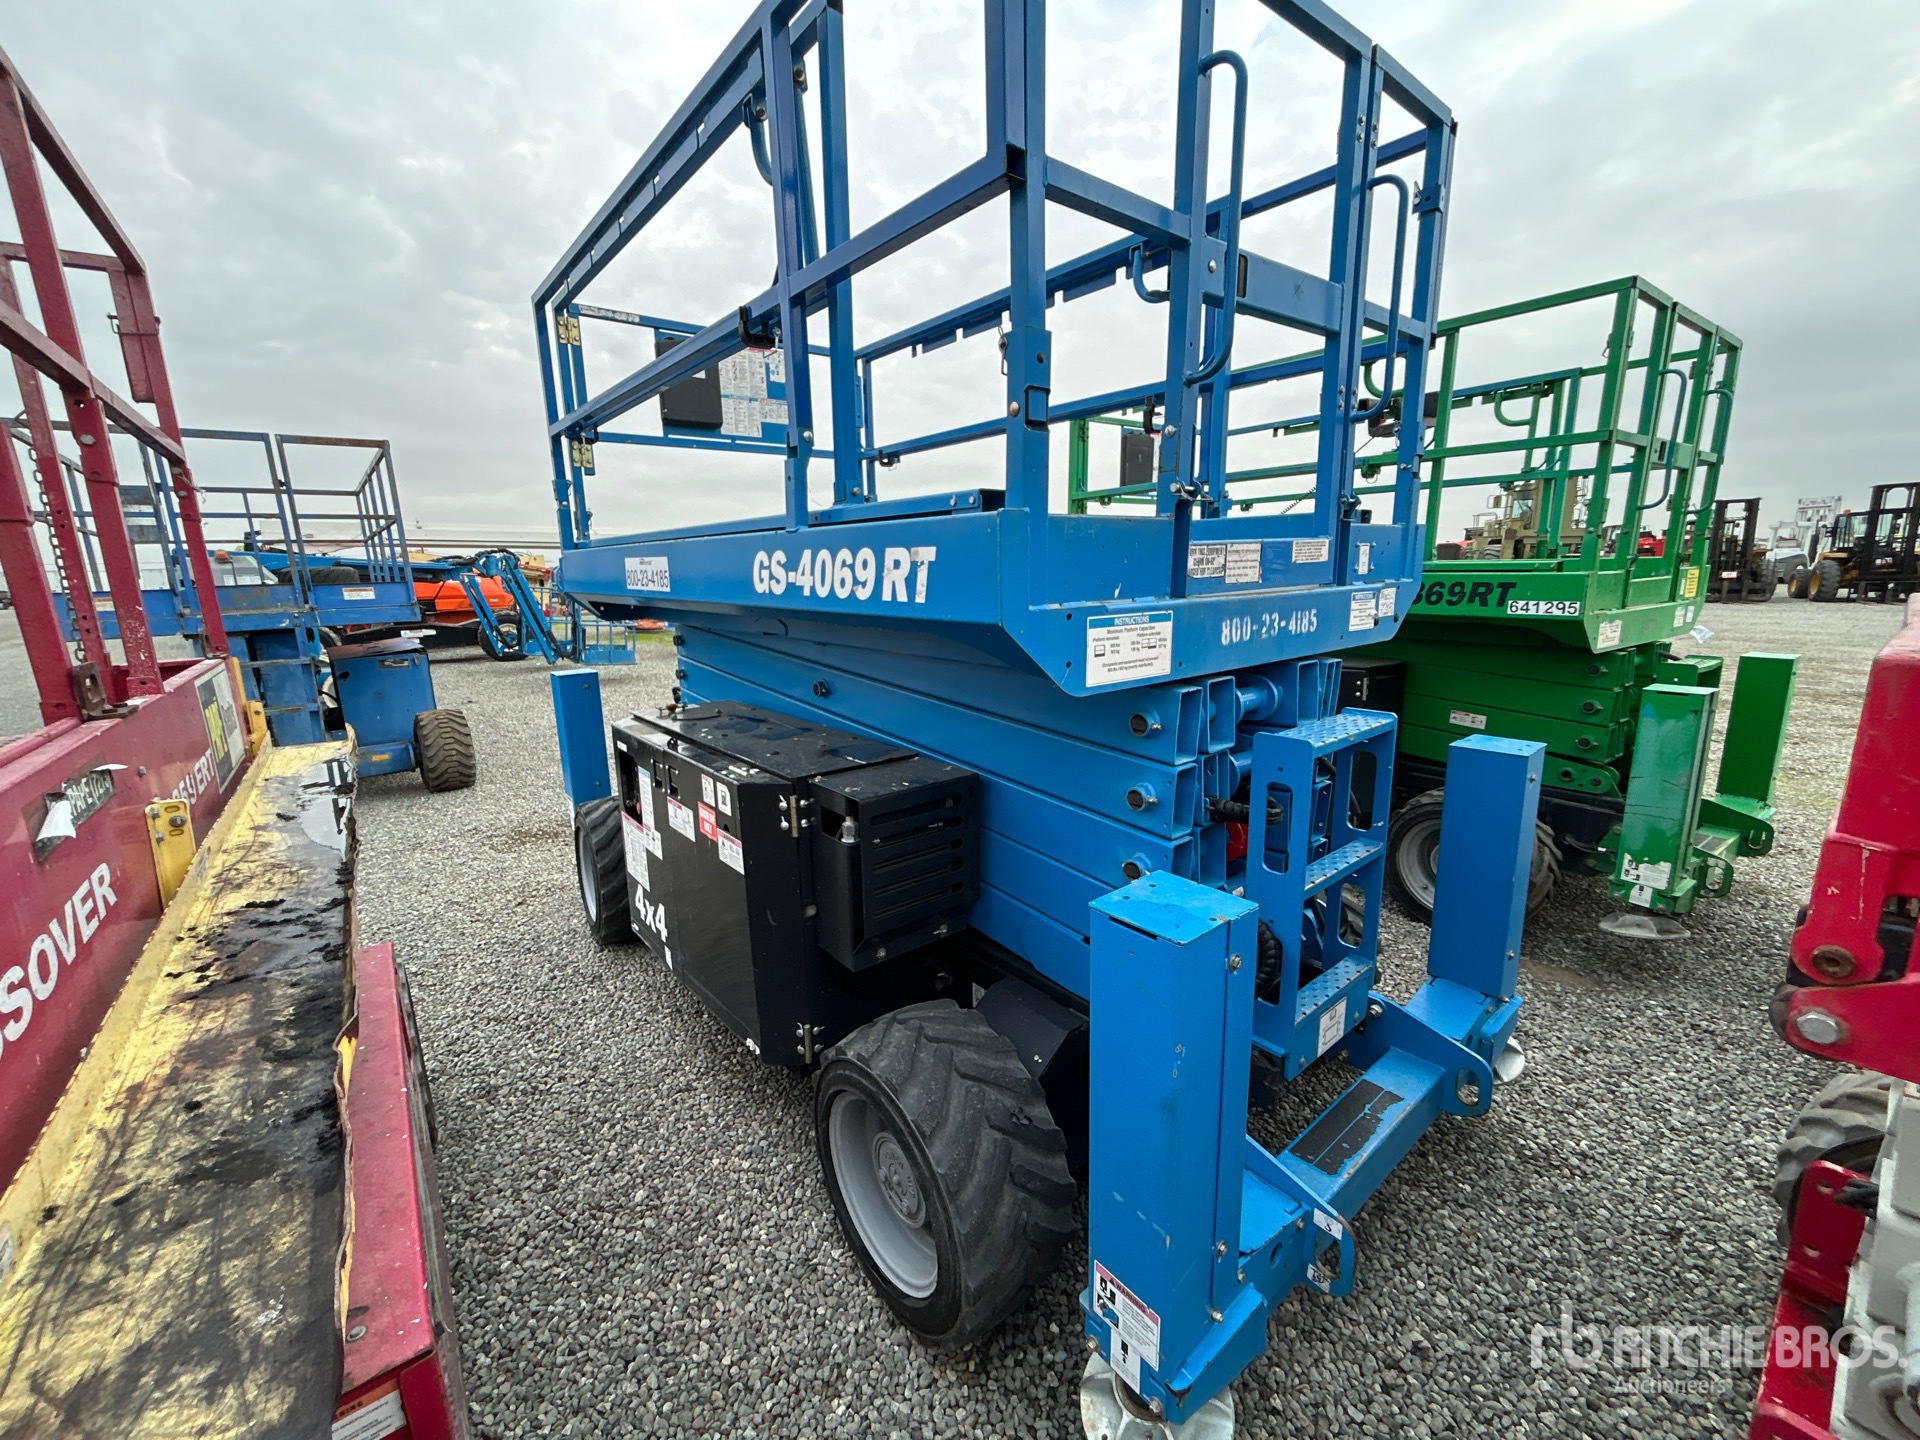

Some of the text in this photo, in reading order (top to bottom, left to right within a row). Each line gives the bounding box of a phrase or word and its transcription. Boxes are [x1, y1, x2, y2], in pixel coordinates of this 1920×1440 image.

[626, 569, 669, 588] 800-23-4185
[753, 546, 937, 603] GS-4069 RT
[1114, 615, 1150, 626] INSTRUCTIONS
[1508, 600, 1578, 615] 641295
[1221, 608, 1318, 646] 800-23-4185
[0, 862, 117, 1060] SOVER
